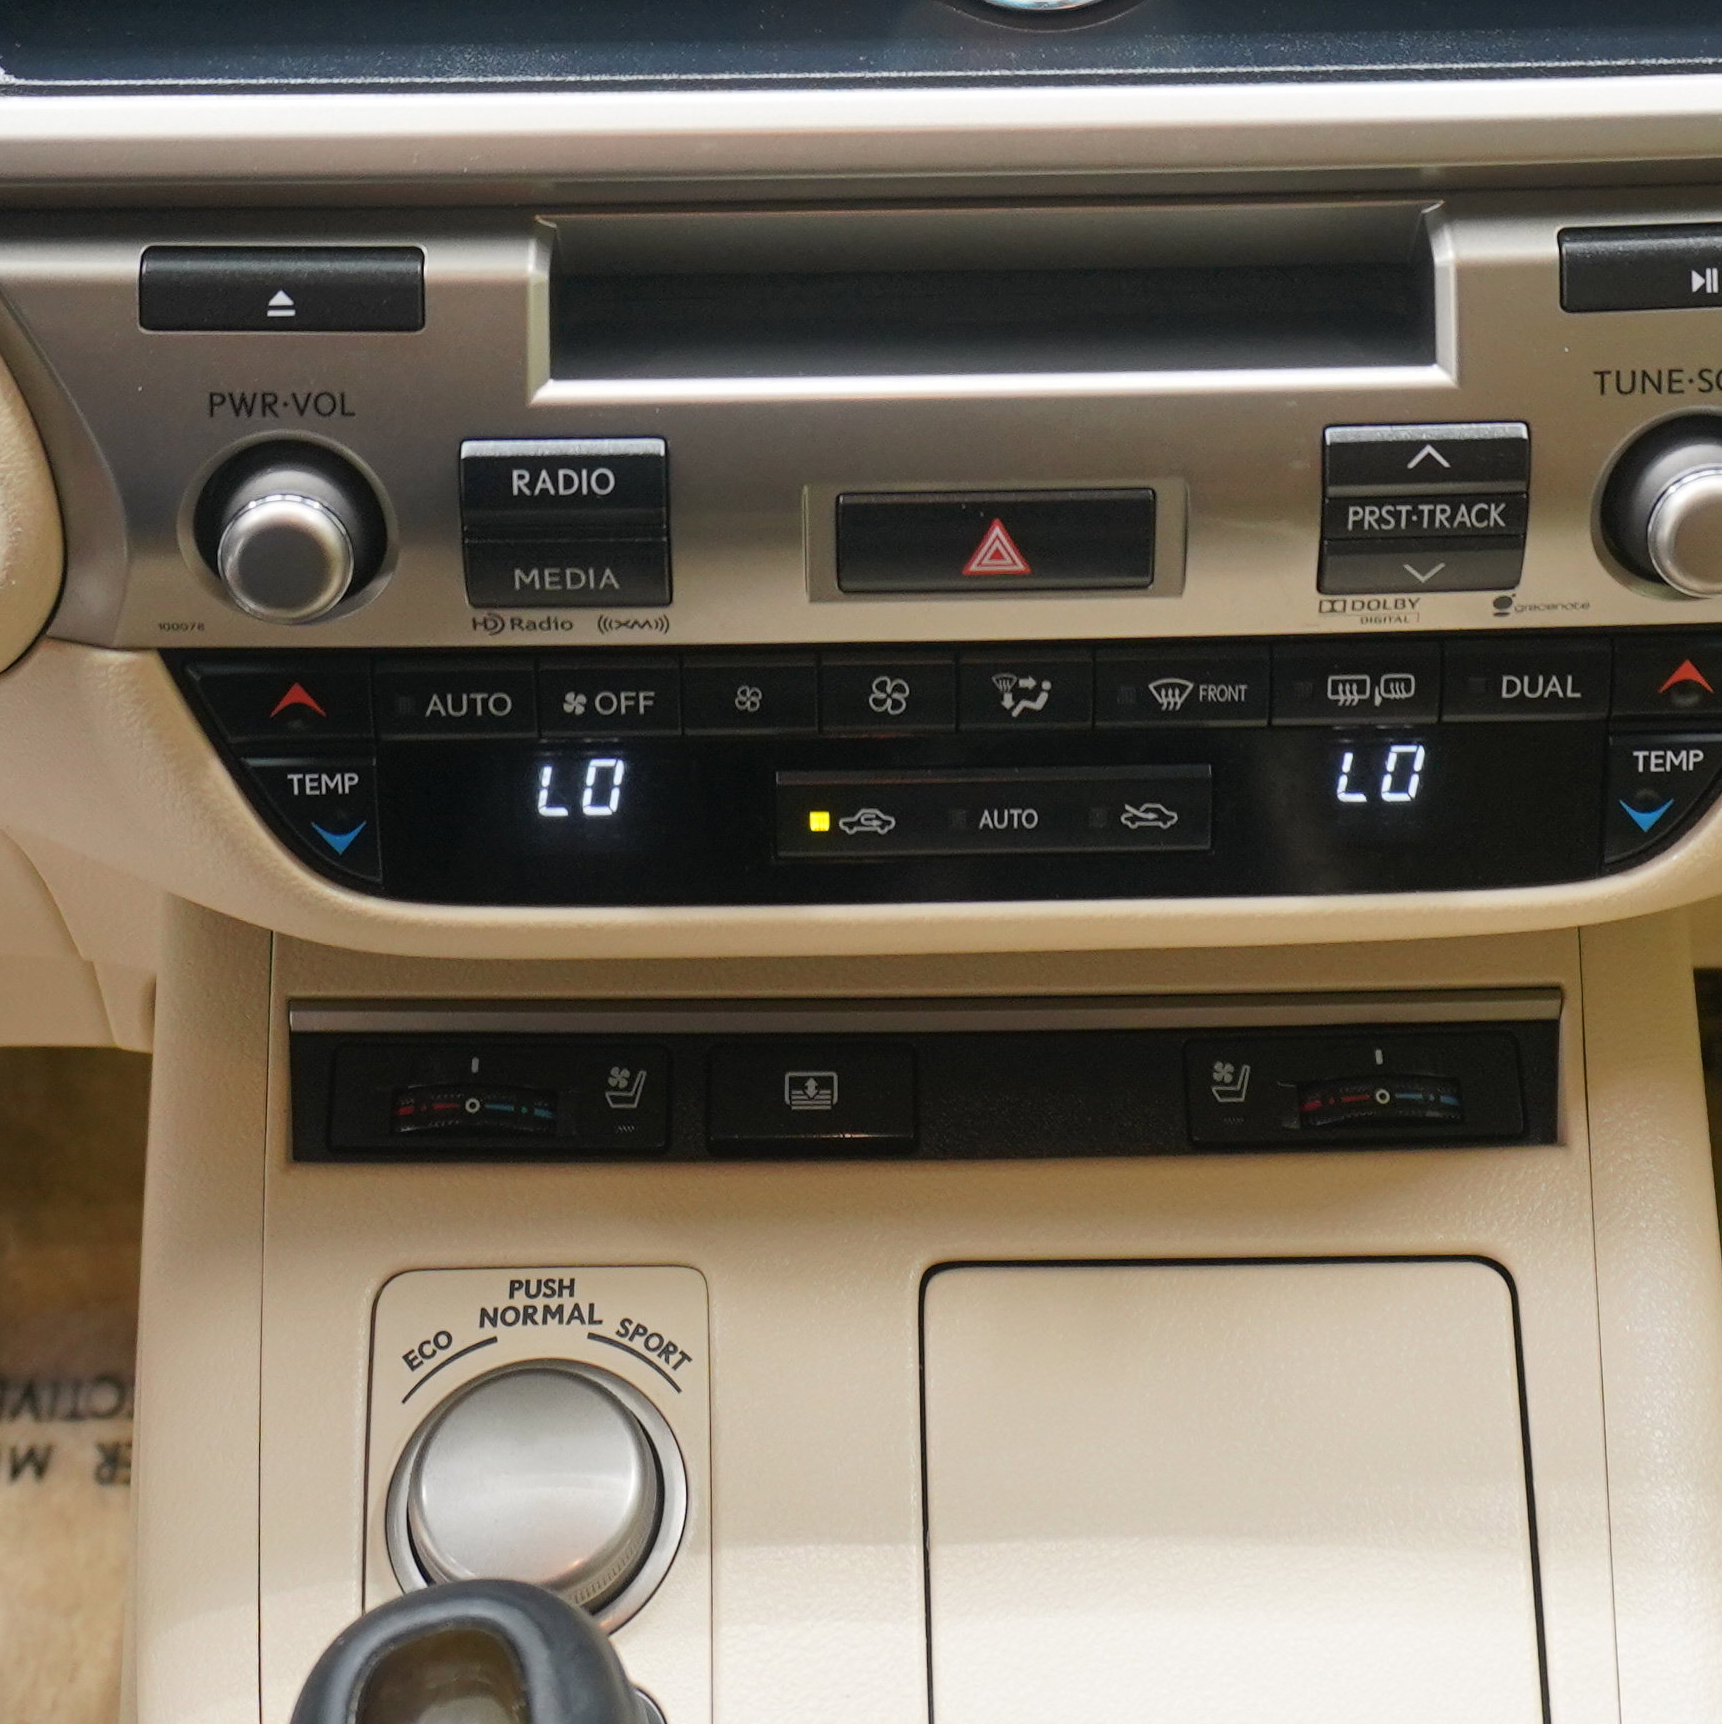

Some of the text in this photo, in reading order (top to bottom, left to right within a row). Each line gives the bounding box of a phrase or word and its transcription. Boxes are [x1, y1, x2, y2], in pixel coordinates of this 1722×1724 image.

[511, 468, 616, 497] RADIO
[513, 566, 620, 591] MEDIA
[1351, 597, 1421, 612] DOLBY
[510, 614, 574, 632] Radio
[1360, 615, 1410, 625] DIGITAL
[1199, 683, 1248, 704] FRONT
[1500, 673, 1582, 700] DUAL
[425, 691, 513, 719] AUTO
[594, 690, 656, 716] OFF
[1632, 749, 1704, 774] TEMP
[287, 772, 360, 797] TEMP
[979, 808, 1039, 831] AUTO
[507, 1277, 577, 1301] PUSH
[401, 1302, 694, 1374] ECO NORMAL SPORT
